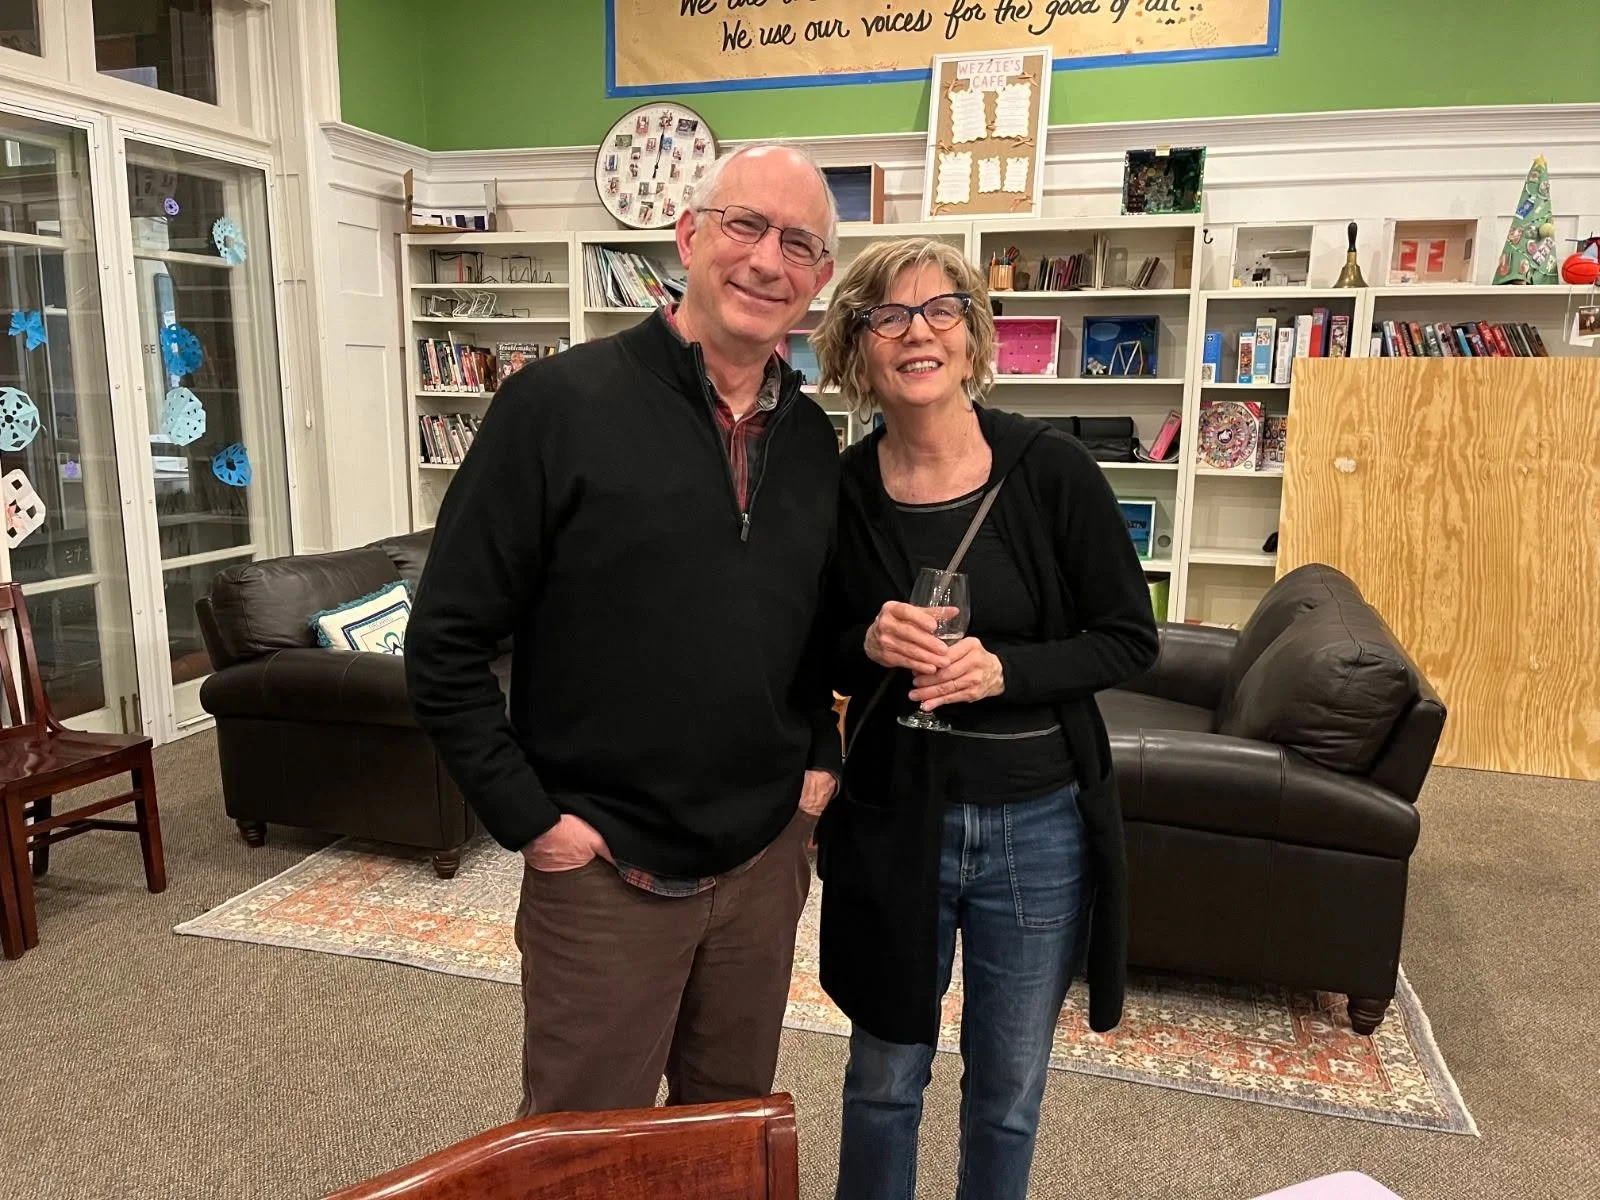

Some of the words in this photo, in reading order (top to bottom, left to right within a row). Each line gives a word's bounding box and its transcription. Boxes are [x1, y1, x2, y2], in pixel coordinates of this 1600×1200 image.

[721, 19, 753, 51] We
[759, 21, 797, 46] use
[804, 18, 851, 41] our
[861, 4, 933, 37] voices
[944, 0, 987, 40] for
[993, 0, 1033, 25] the
[1028, 0, 1101, 35] good
[958, 59, 1021, 75] WEZZIE'S
[972, 75, 1005, 89] CAFE
